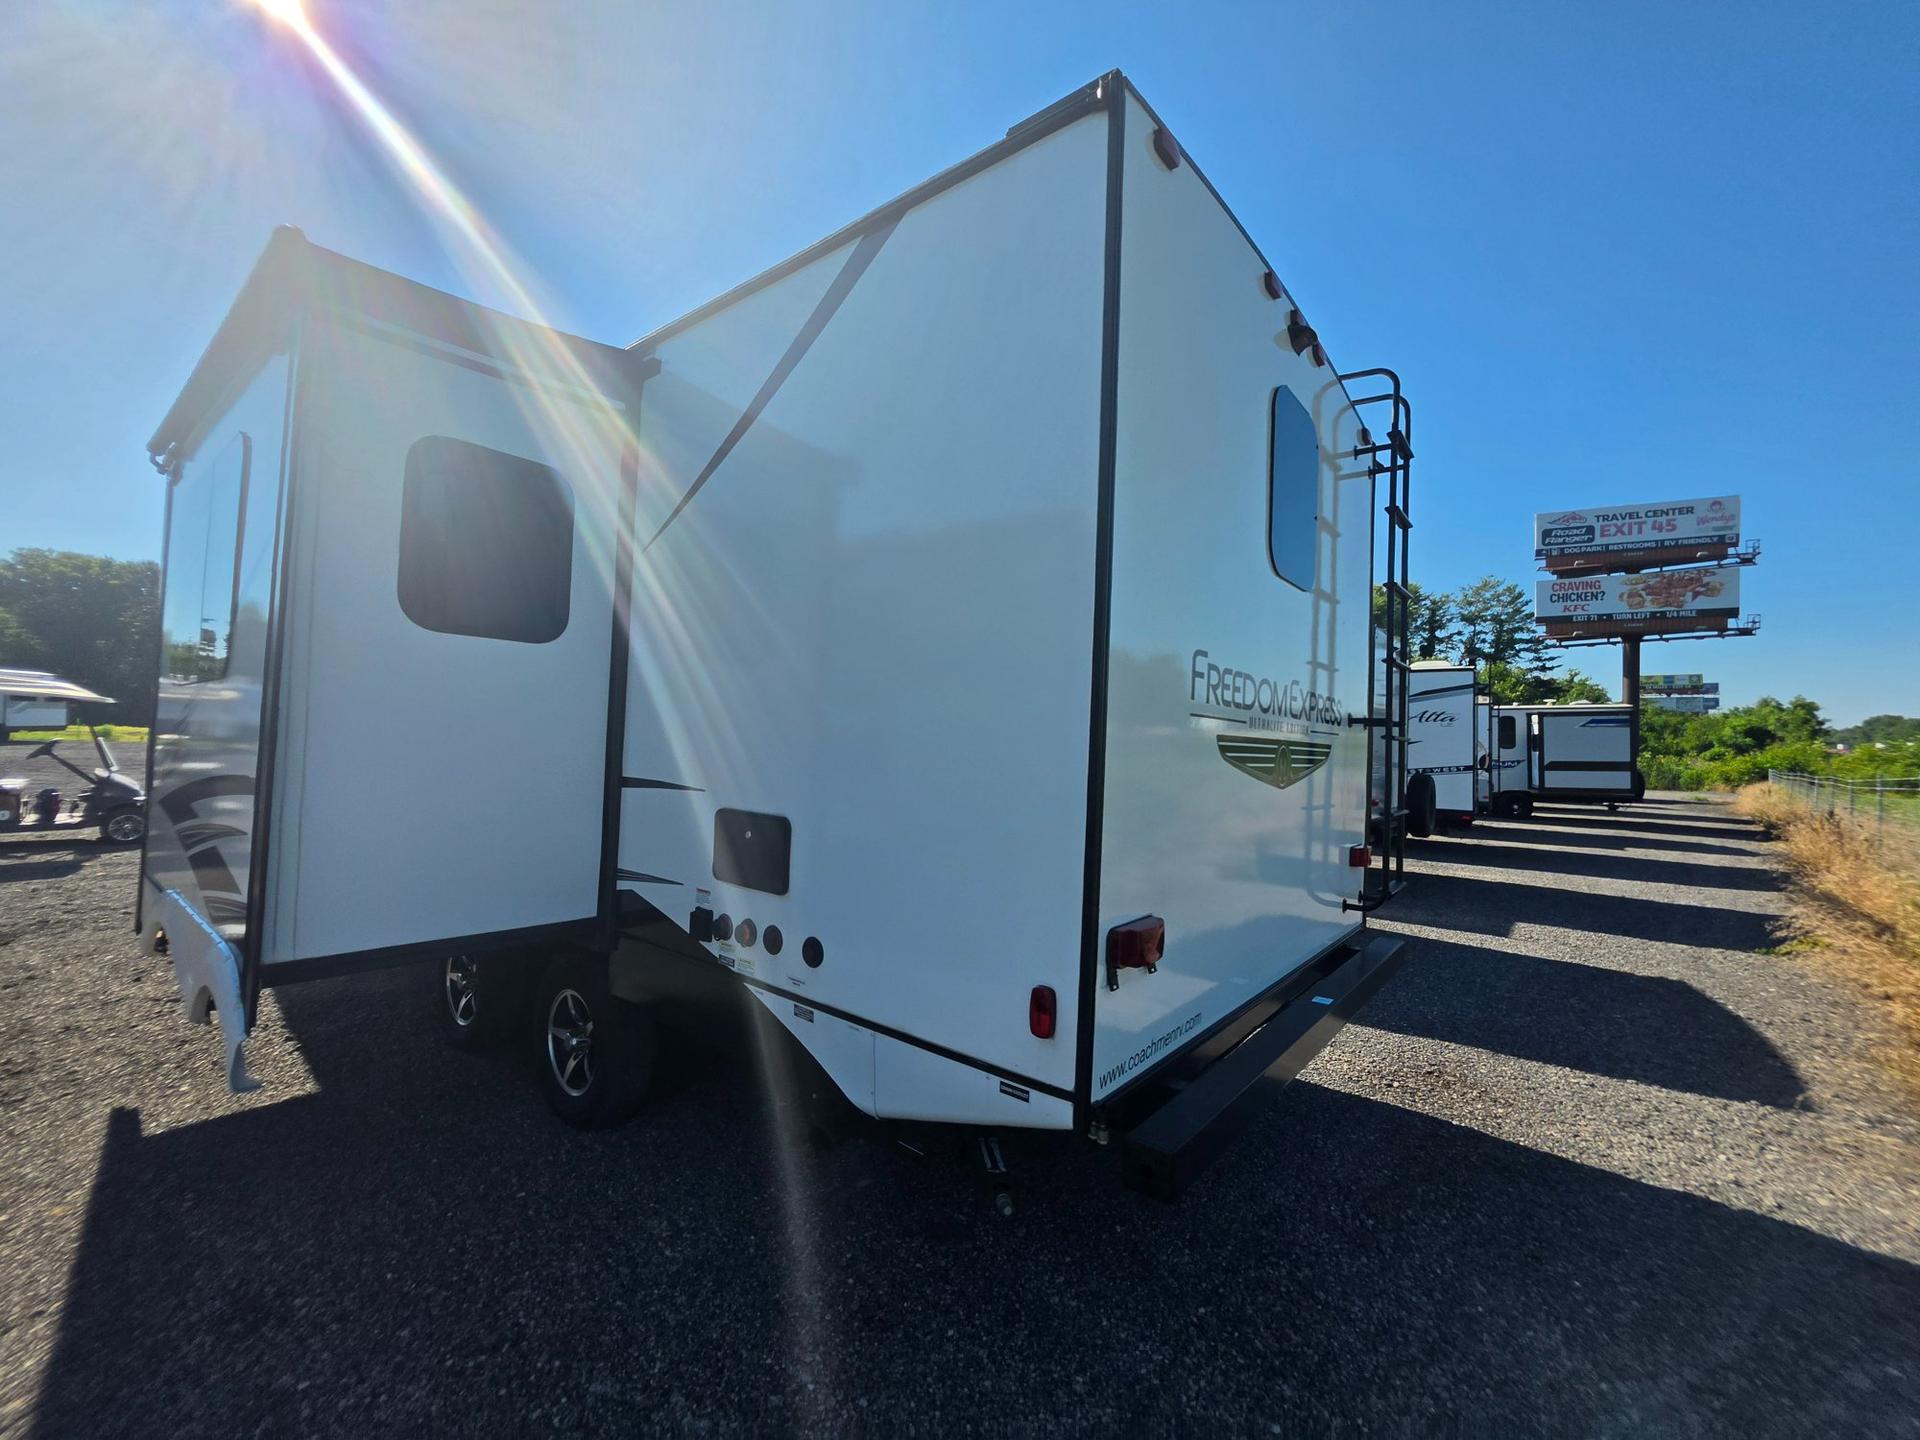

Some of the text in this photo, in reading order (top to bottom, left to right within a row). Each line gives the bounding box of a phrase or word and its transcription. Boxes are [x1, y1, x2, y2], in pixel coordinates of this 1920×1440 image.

[1594, 506, 1695, 523] TRAVEL CENTER
[1551, 527, 1587, 536] Road
[1600, 518, 1678, 537] EXIT 45
[1545, 534, 1592, 545] Ranger
[1609, 541, 1656, 551] RESTROOMS
[1679, 536, 1719, 545] FRIENDLY
[1552, 580, 1601, 593] CRAVING
[1550, 590, 1606, 603] CHICKEN?
[1563, 603, 1590, 613] KFC
[1409, 709, 1458, 723] Alta
[1098, 1011, 1203, 1090] www.coachmenrv.com
